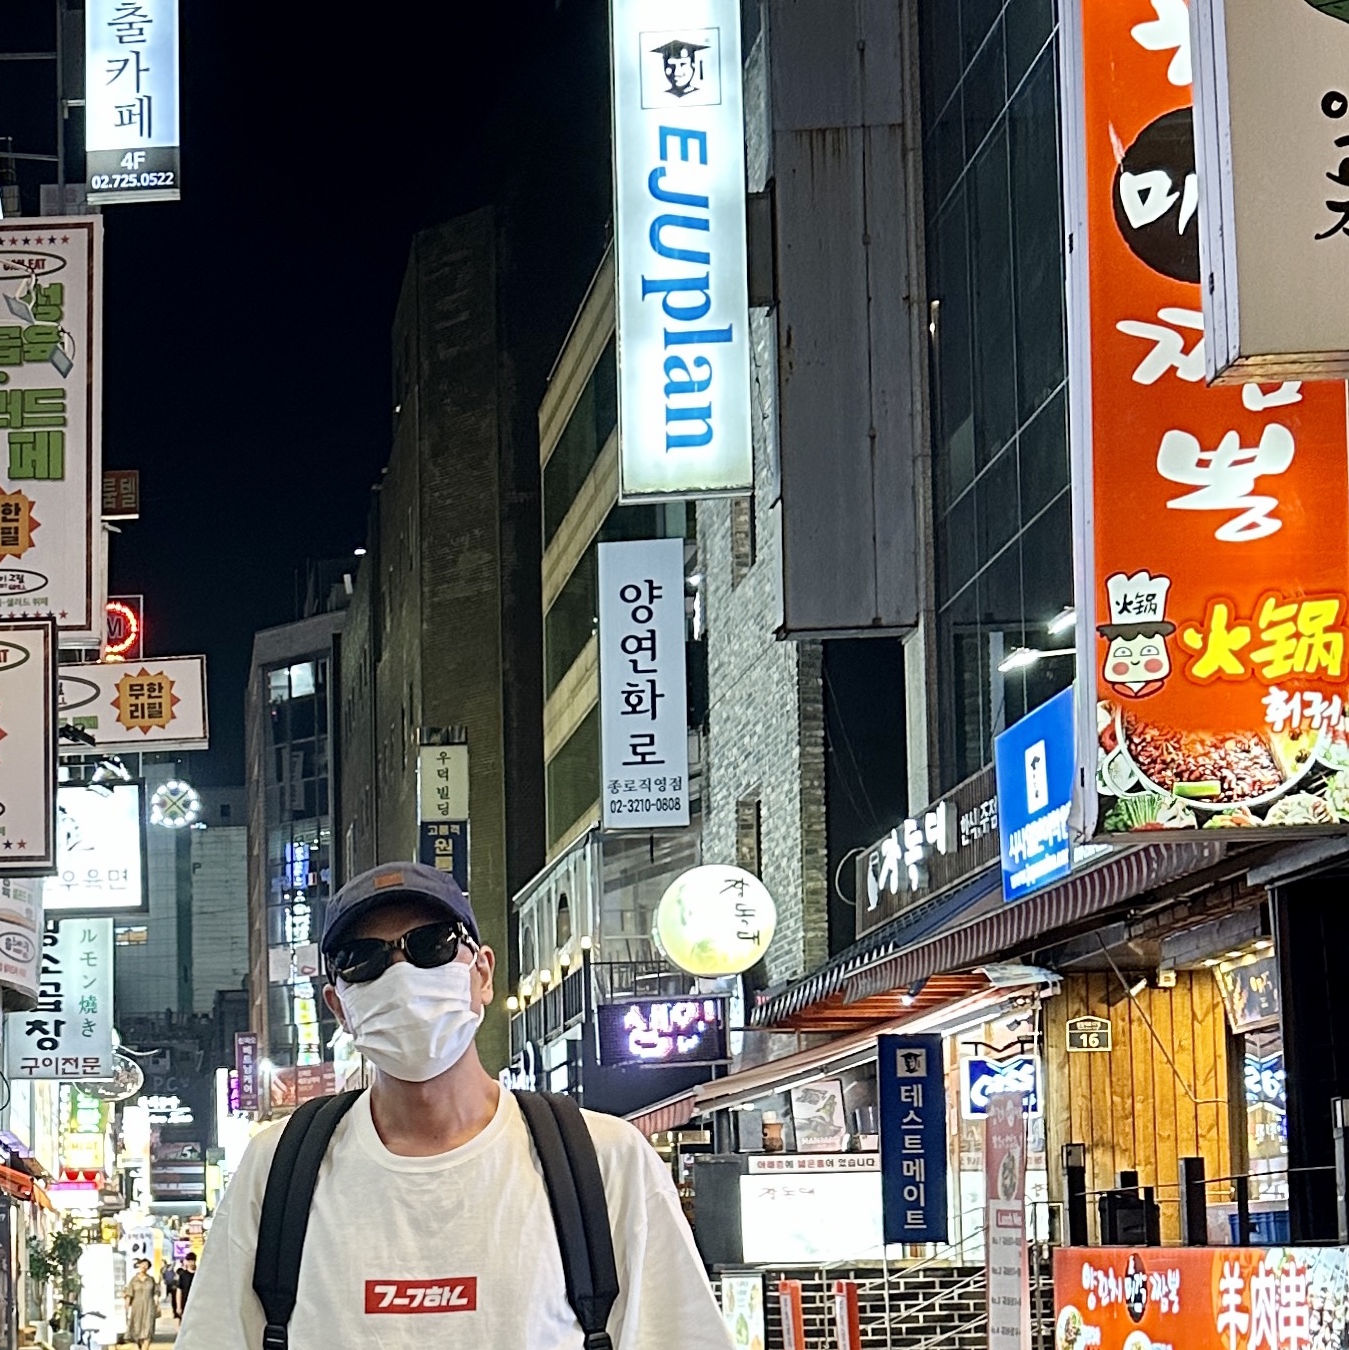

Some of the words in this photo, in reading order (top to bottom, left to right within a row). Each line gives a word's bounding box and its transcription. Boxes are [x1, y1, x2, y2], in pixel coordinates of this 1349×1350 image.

[120, 151, 146, 170] 4F
[91, 172, 174, 189] 02.725.0522
[641, 125, 733, 454] EJUplan
[1115, 592, 1157, 615] 火锅
[1183, 597, 1344, 679] 火锅
[620, 579, 665, 766] 양연화로
[128, 682, 164, 700] 무한
[129, 702, 164, 720] 리필
[607, 776, 683, 794] 종로직영점
[610, 798, 682, 814] 02-3210-0808
[47, 868, 128, 891] 우육면
[1080, 1033, 1100, 1048] 16
[20, 1057, 101, 1075] 구이전문
[899, 1083, 928, 1231] 테스트메이트
